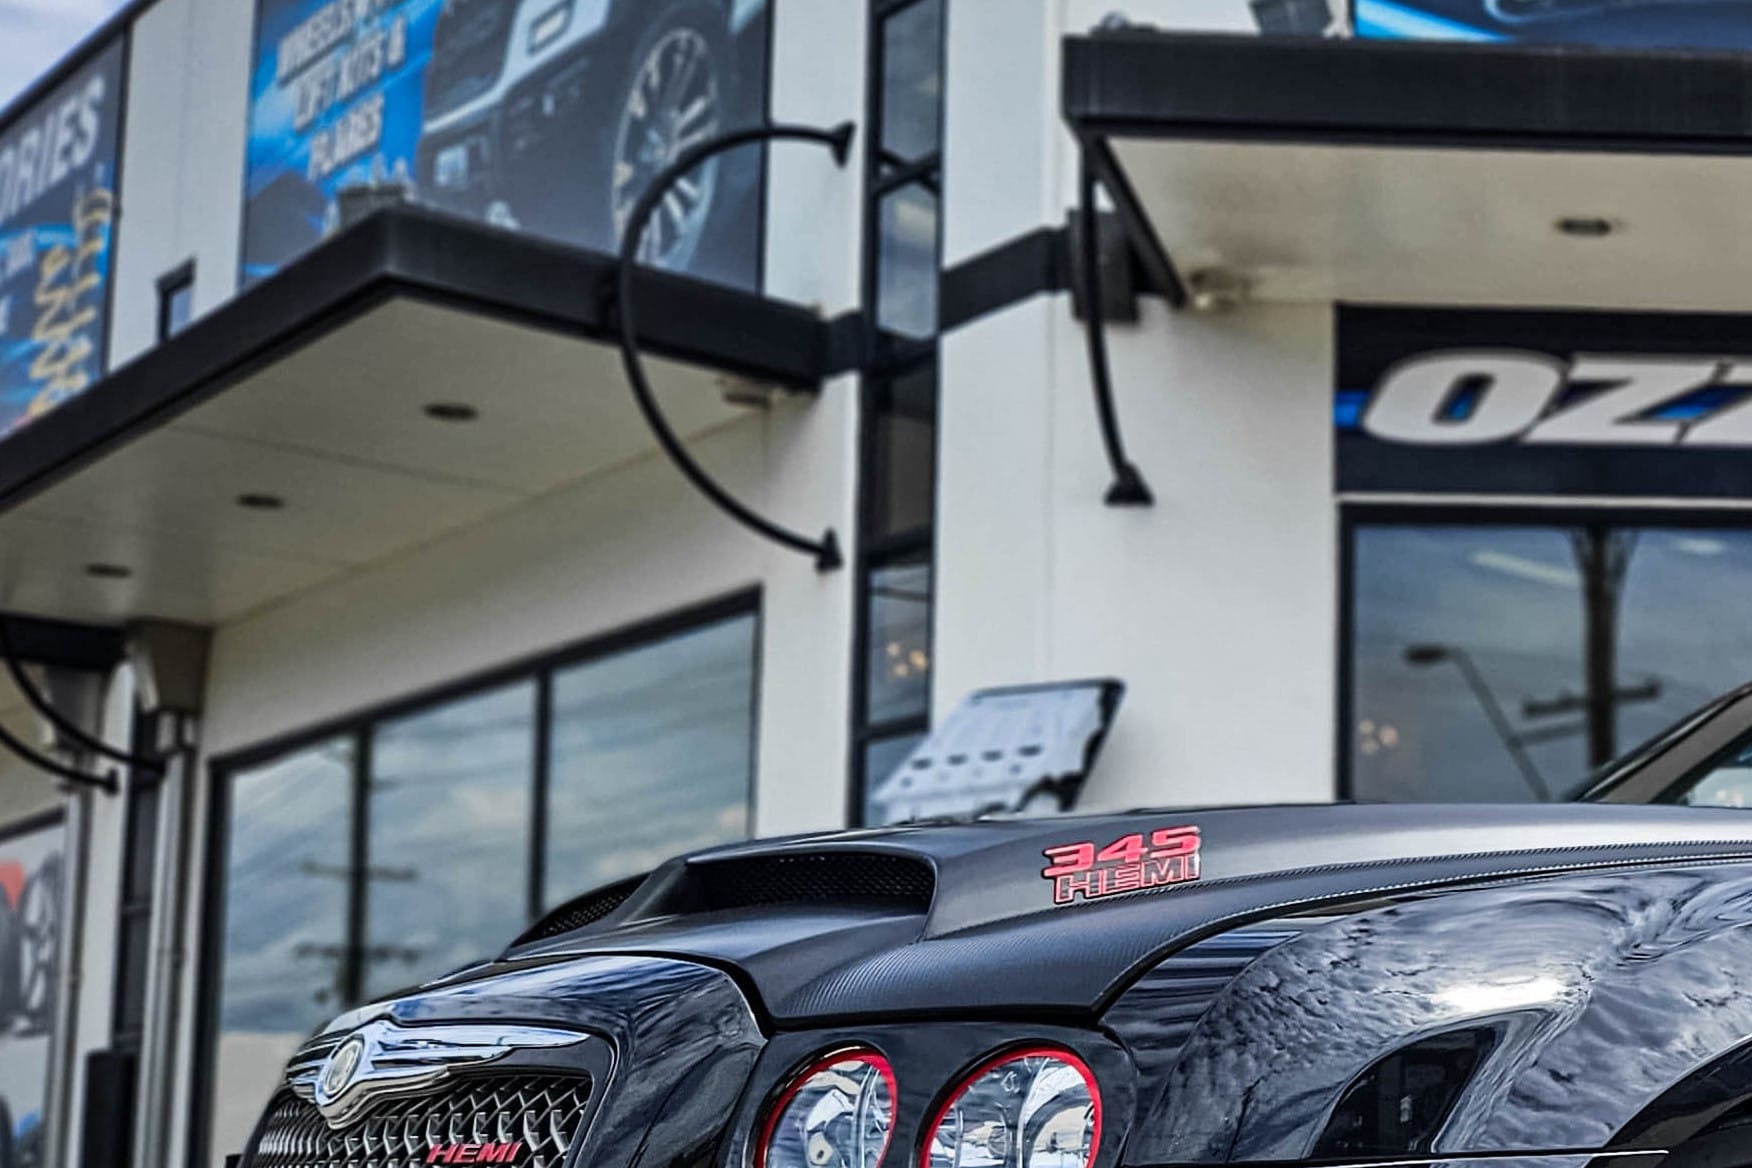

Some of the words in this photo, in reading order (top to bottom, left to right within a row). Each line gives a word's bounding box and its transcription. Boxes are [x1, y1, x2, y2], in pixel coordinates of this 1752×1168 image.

[1043, 826, 1201, 878] 345
[1055, 853, 1200, 904] HEMI
[426, 1142, 523, 1165] HEMI
